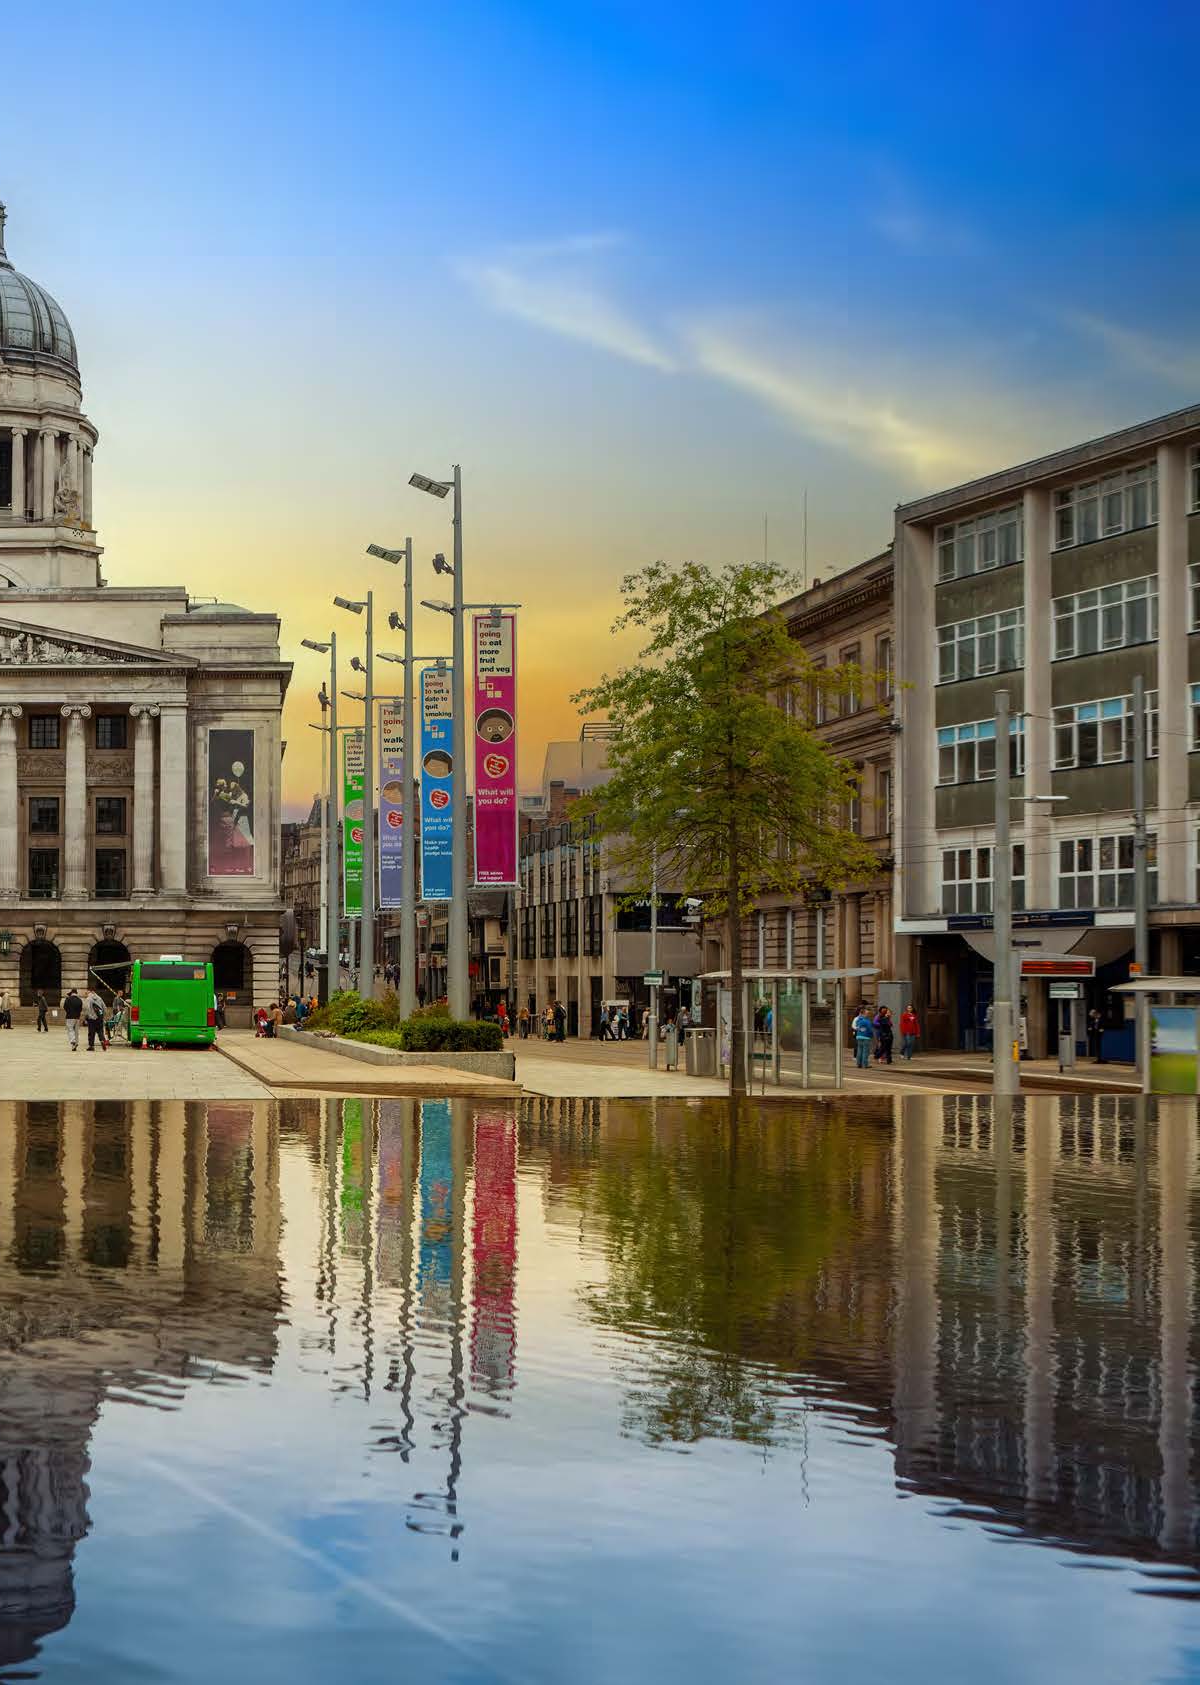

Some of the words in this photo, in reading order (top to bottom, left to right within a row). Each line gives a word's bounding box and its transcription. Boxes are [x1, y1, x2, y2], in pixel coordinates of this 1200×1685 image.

[480, 630, 501, 638] going
[500, 788, 514, 796] will
[479, 798, 492, 806] you
[494, 797, 508, 805] do?
